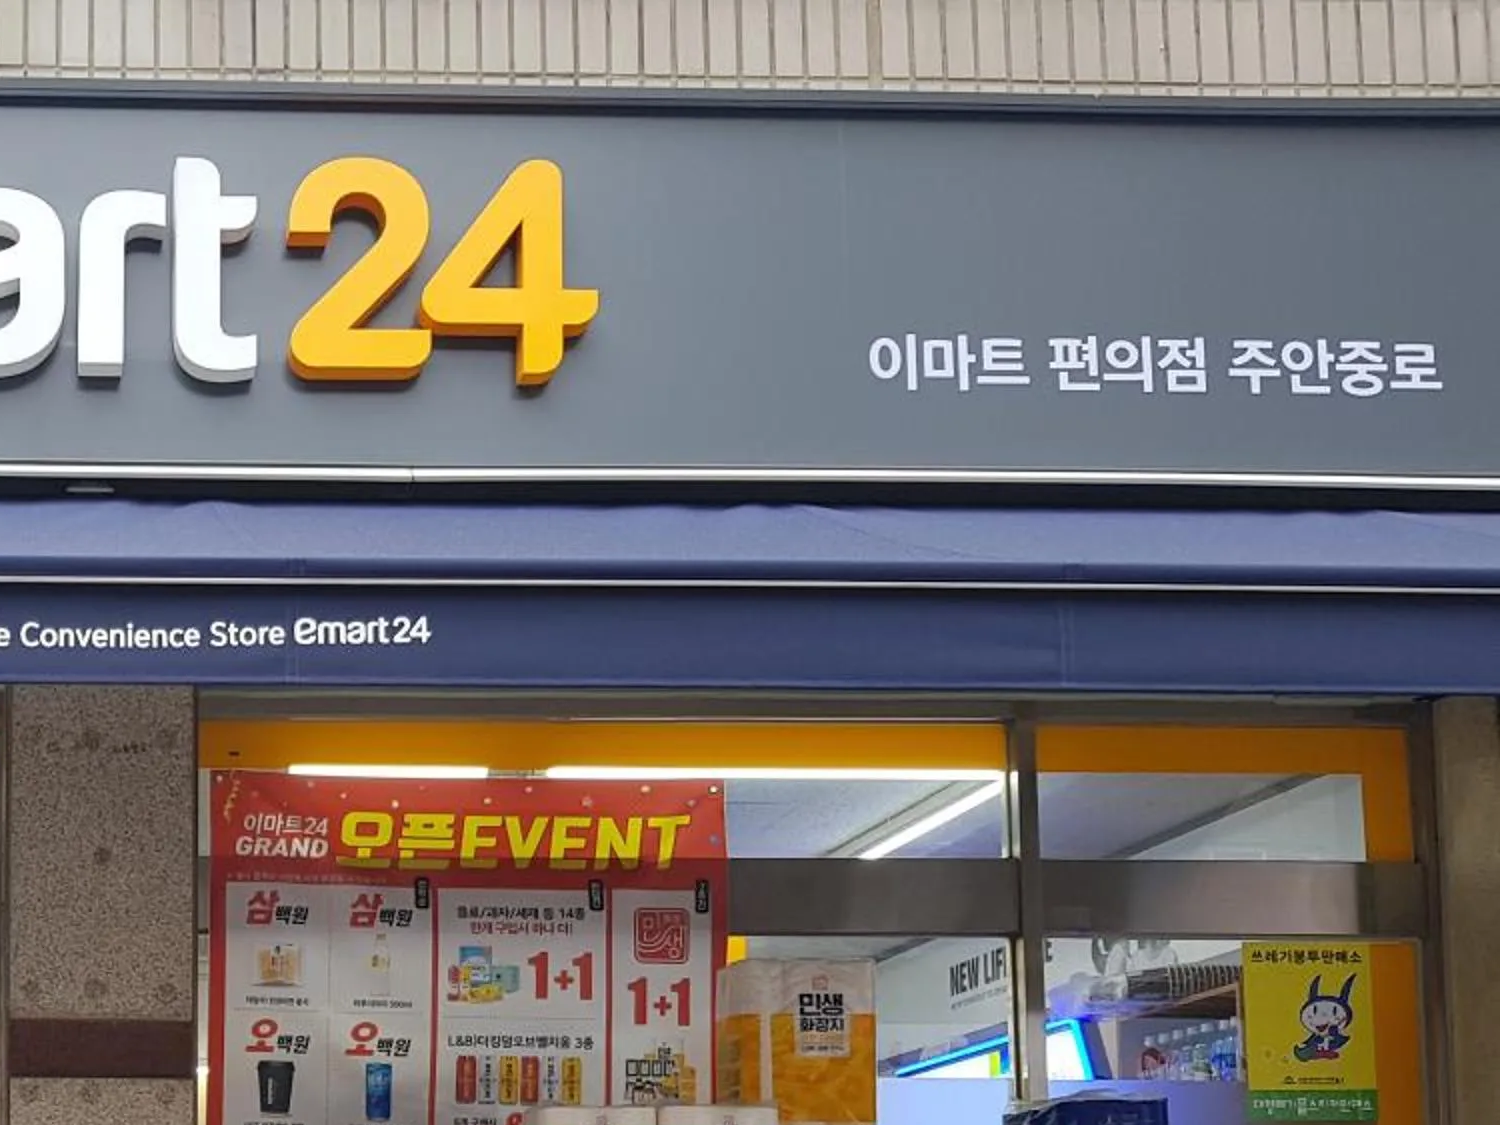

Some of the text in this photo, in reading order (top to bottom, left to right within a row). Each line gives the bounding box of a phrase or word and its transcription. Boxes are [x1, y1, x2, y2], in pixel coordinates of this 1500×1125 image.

[868, 334, 1443, 397] 이마트 편의점 주안중로
[19, 621, 201, 649] Convenience
[209, 621, 286, 647] Store
[293, 615, 432, 646] emart24
[243, 812, 330, 837] 이마트24
[235, 834, 330, 859] GRAND
[949, 955, 980, 997] NEW
[983, 945, 1007, 985] LIF
[1251, 948, 1363, 966] 쓰레기봉투판매소
[527, 951, 593, 1001] 1+1
[628, 976, 691, 1027] 1+1
[798, 993, 844, 1016] 민생
[799, 1017, 845, 1032] 화장지
